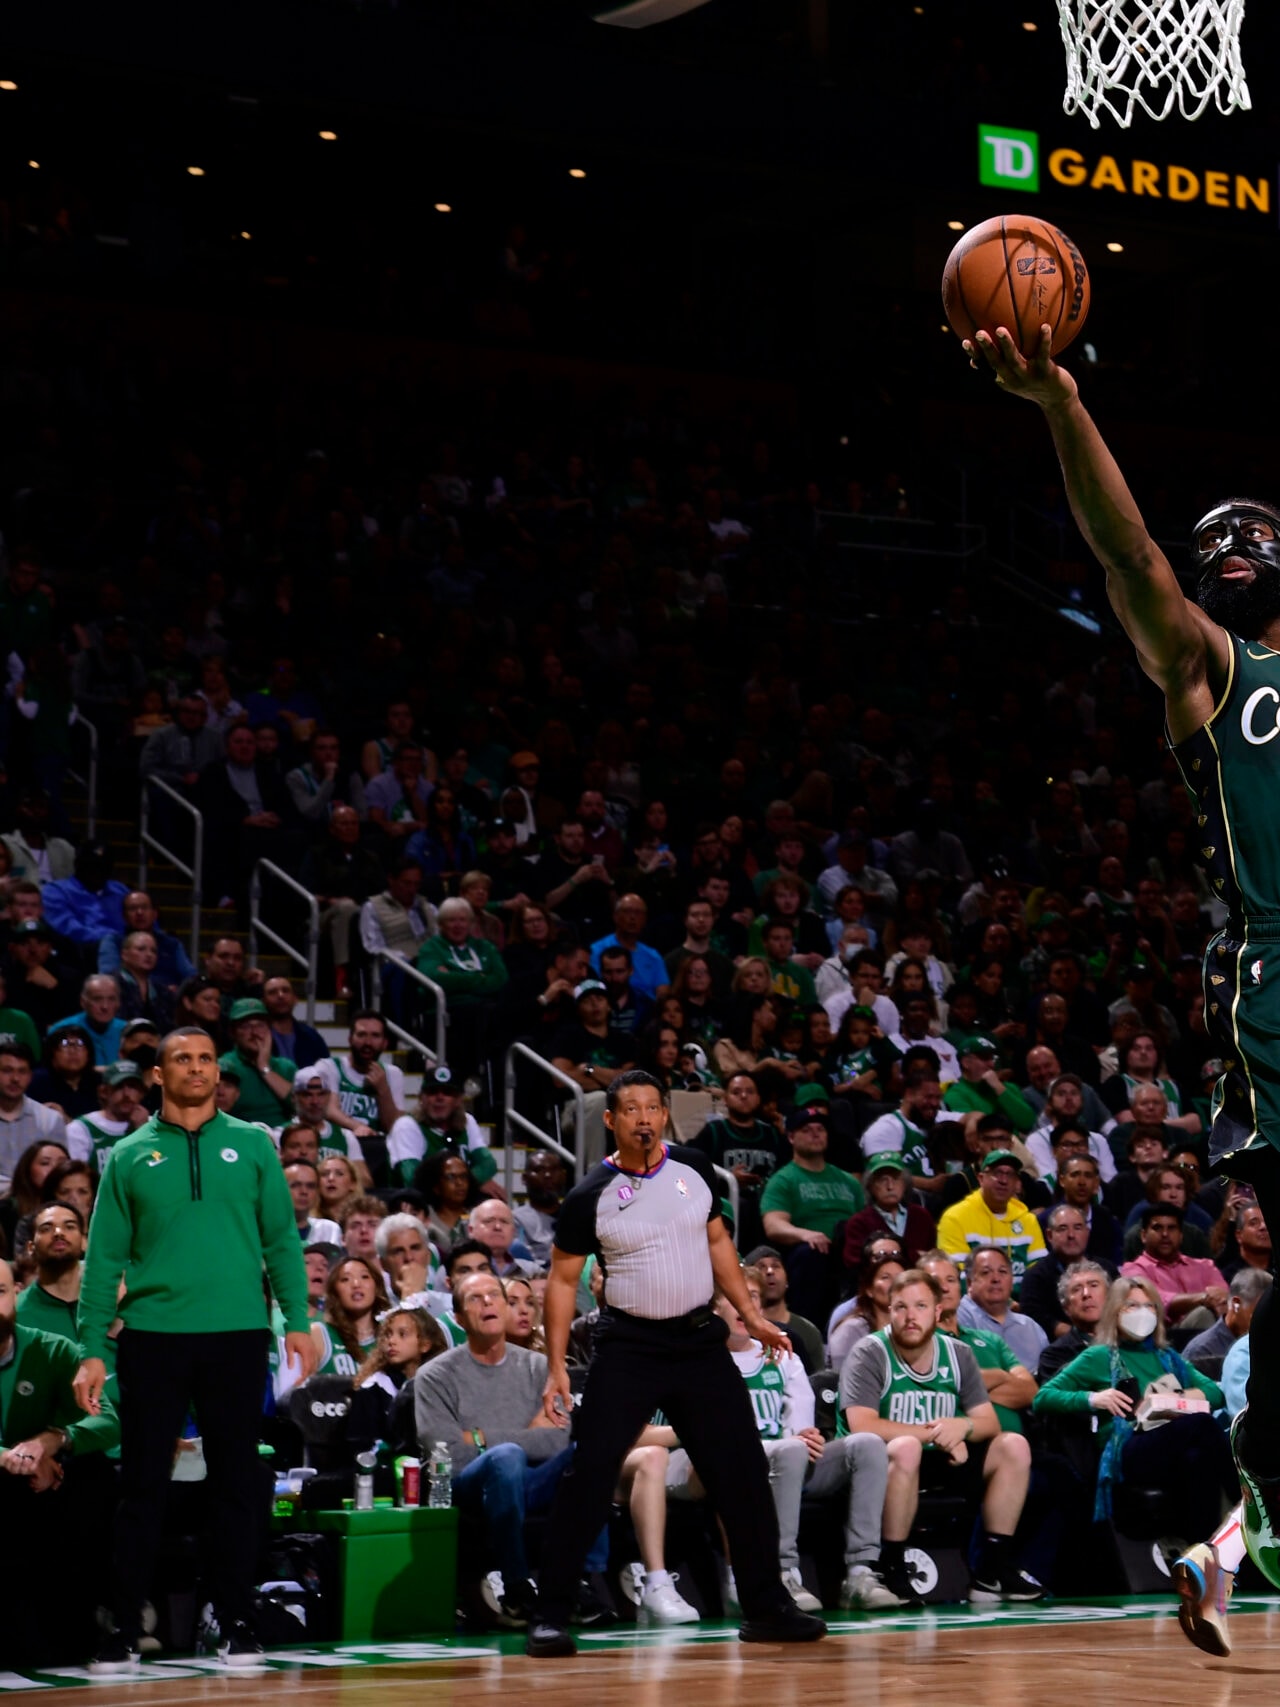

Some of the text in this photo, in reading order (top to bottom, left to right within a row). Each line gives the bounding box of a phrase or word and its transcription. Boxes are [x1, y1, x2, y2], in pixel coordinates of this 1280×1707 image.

[984, 135, 1269, 213] TD GARDEN
[889, 1390, 956, 1425] BOSTON
